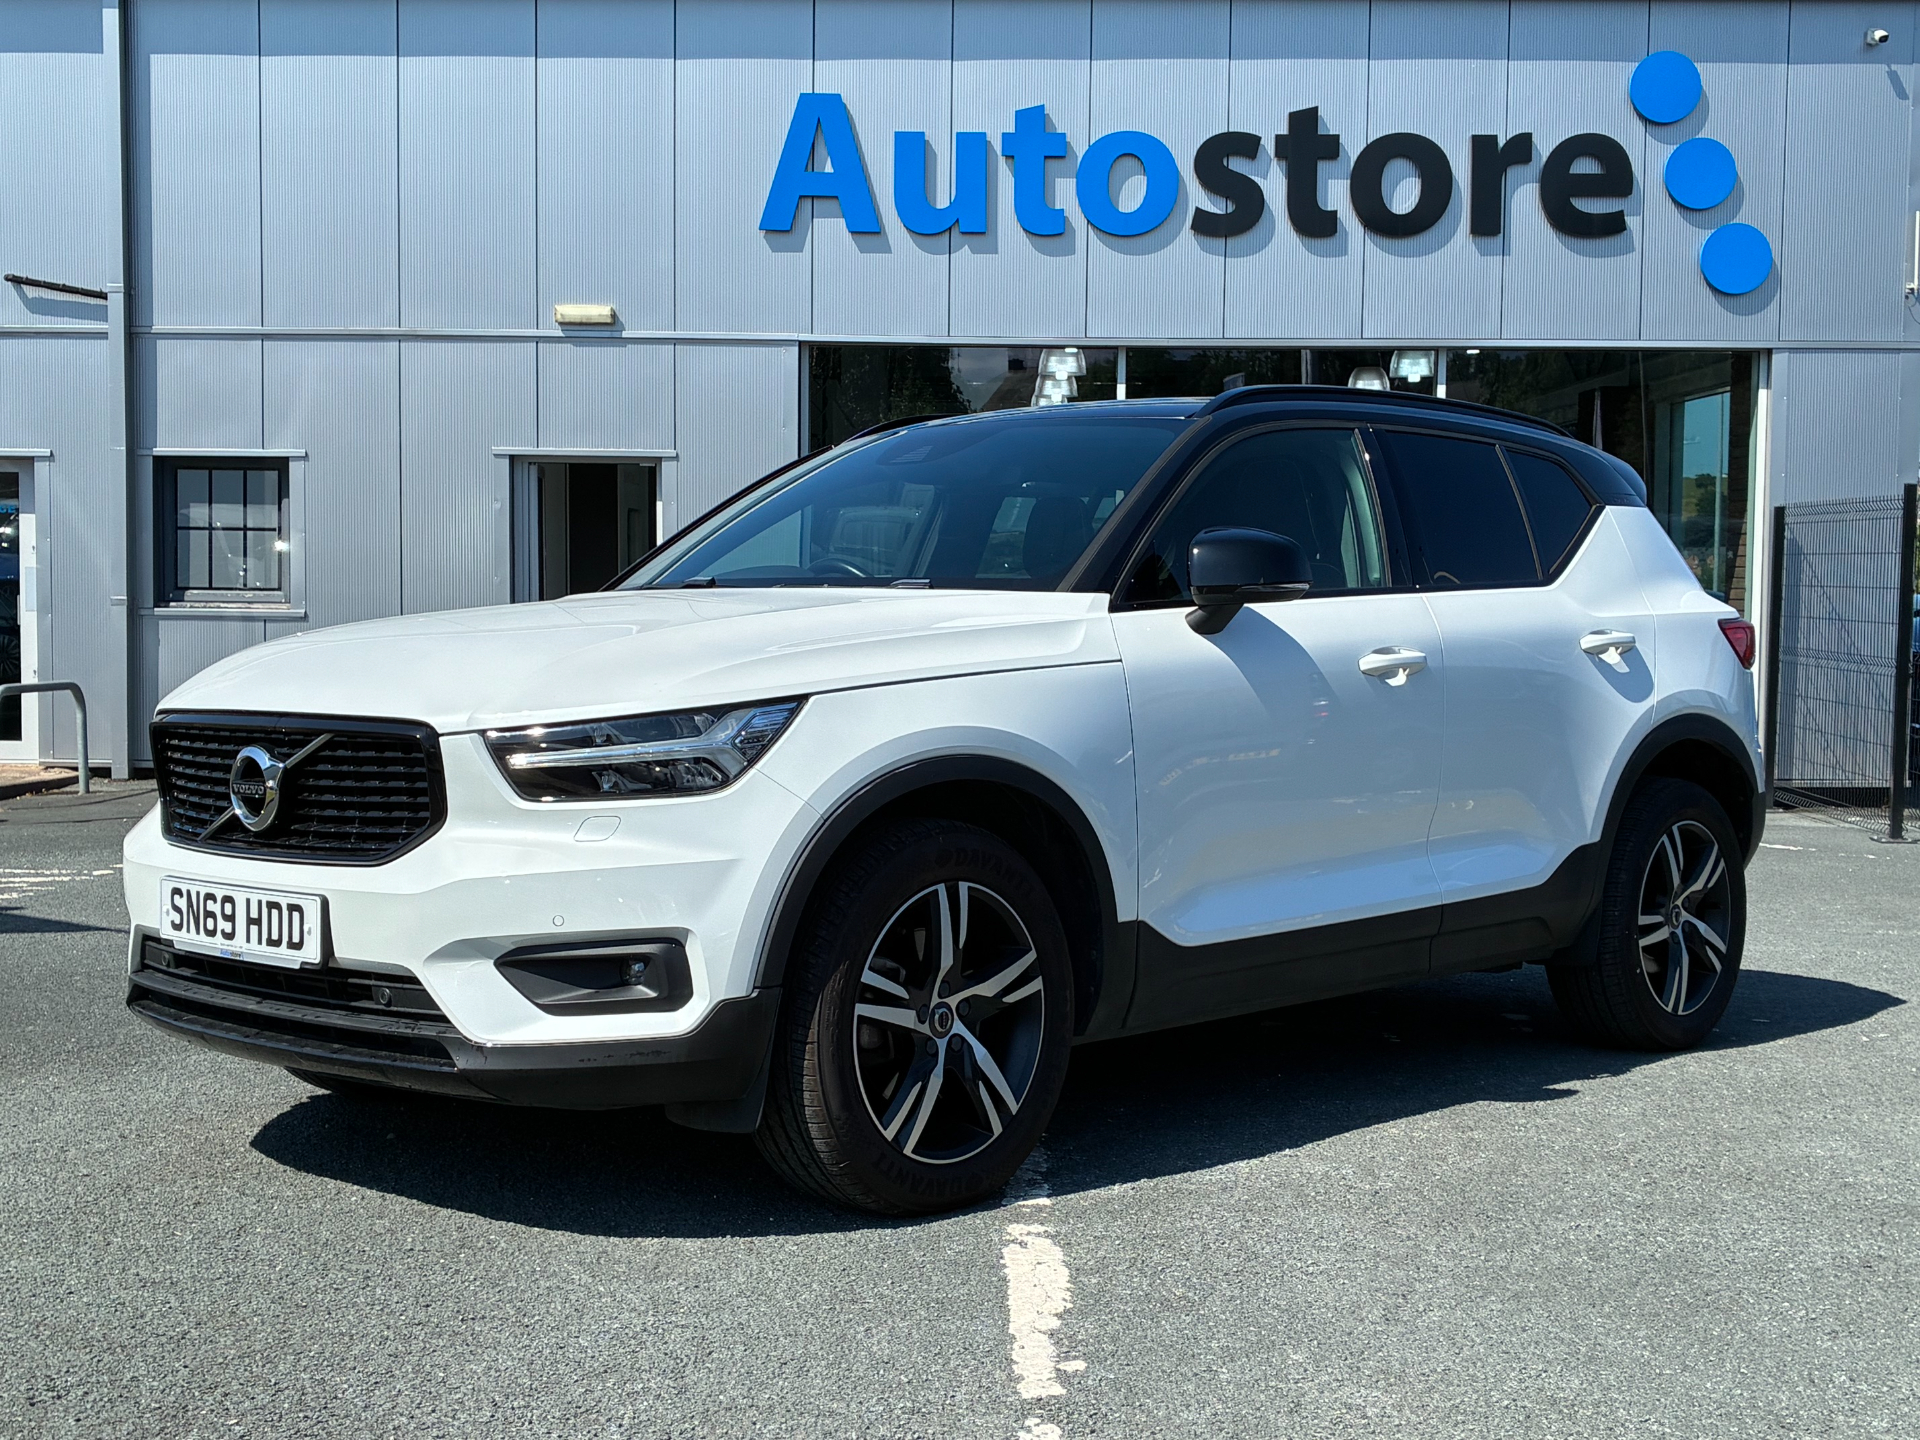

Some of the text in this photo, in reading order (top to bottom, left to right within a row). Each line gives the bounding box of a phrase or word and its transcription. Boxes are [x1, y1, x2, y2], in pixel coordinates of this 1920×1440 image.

[758, 92, 1635, 238] Autostore
[232, 784, 265, 794] VOLVO
[170, 887, 305, 951] SN69 HDD
